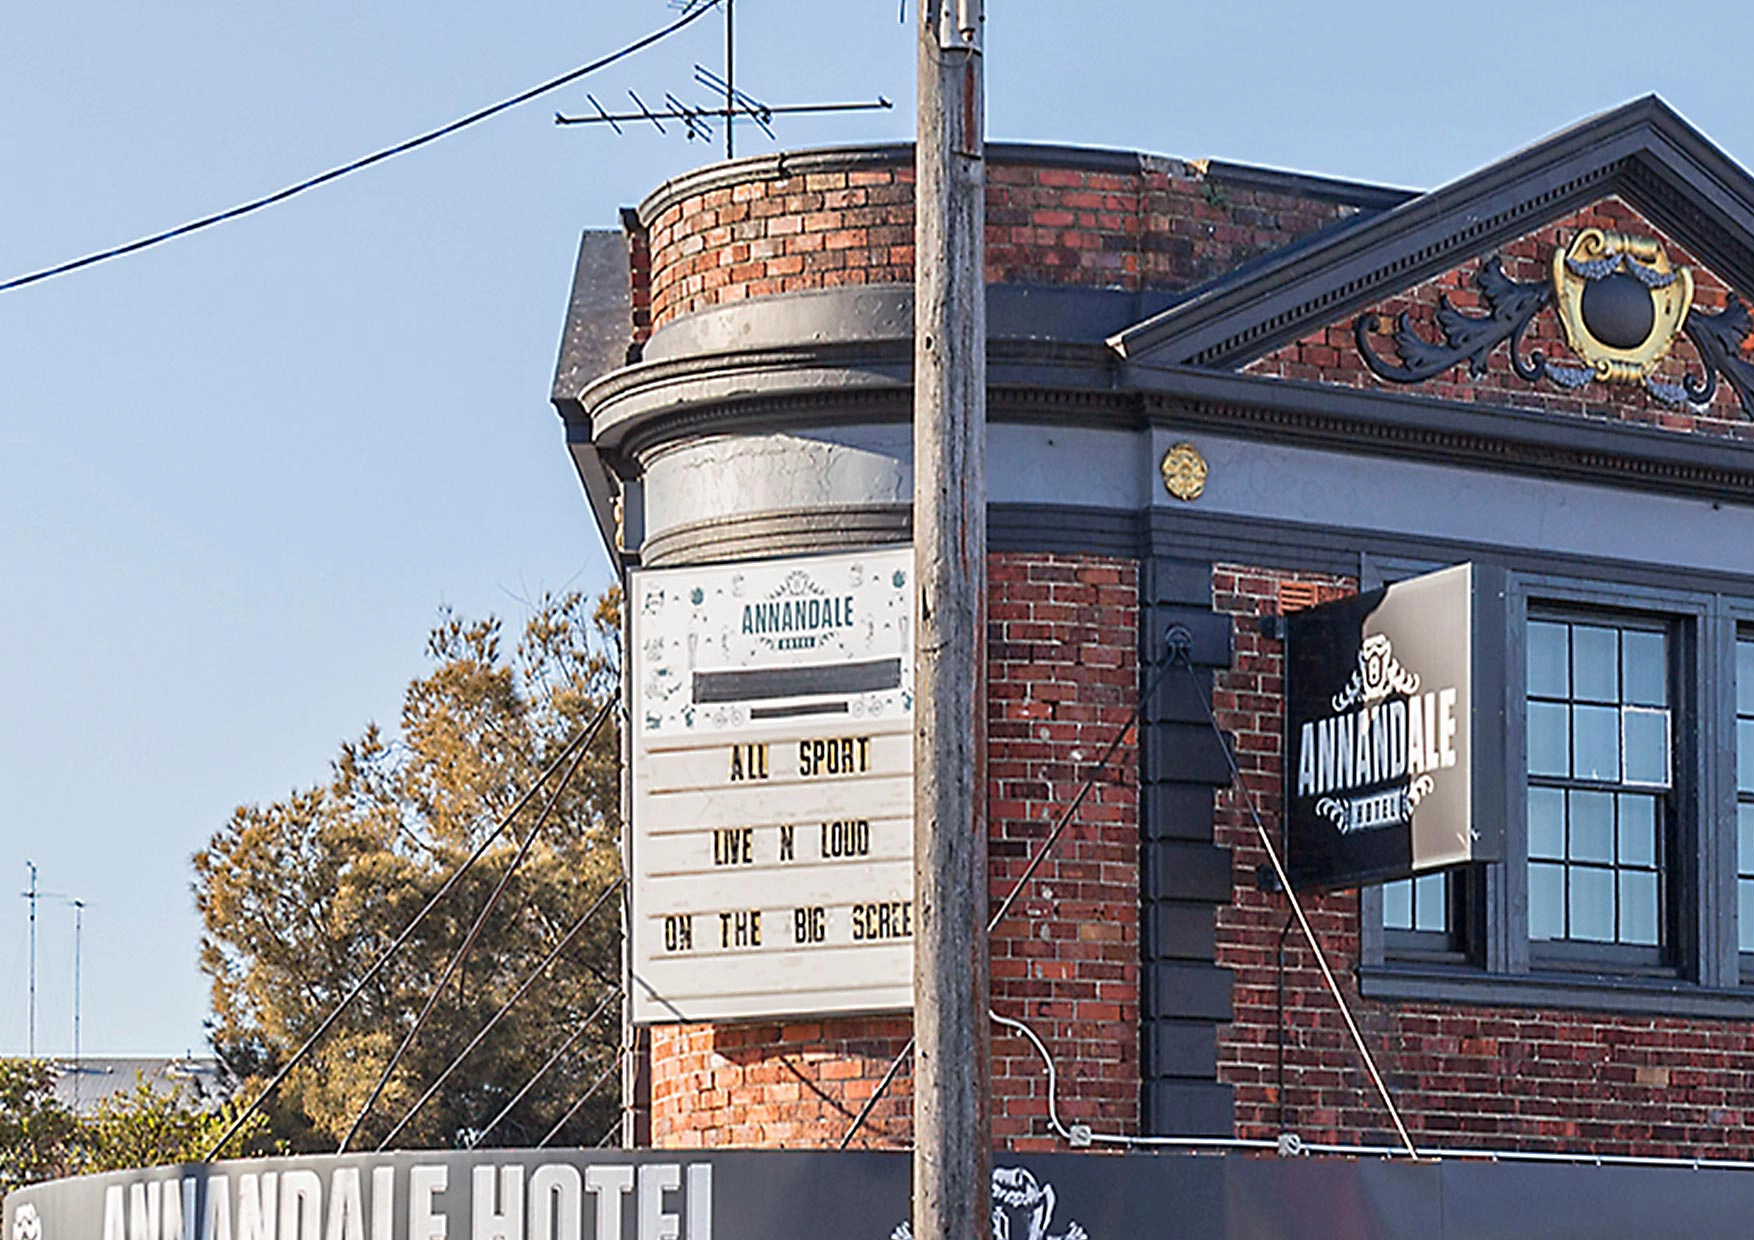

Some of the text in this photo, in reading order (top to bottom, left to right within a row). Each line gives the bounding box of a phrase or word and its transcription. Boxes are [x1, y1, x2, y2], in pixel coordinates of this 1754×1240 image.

[741, 595, 855, 636] ANNANDALE
[729, 736, 870, 781] ALL SPORT
[1298, 687, 1457, 798] ANNANDALE
[713, 819, 870, 866] LIVE N LOUD
[664, 915, 693, 952] ON
[719, 910, 762, 948] THE
[794, 906, 826, 945] BIG
